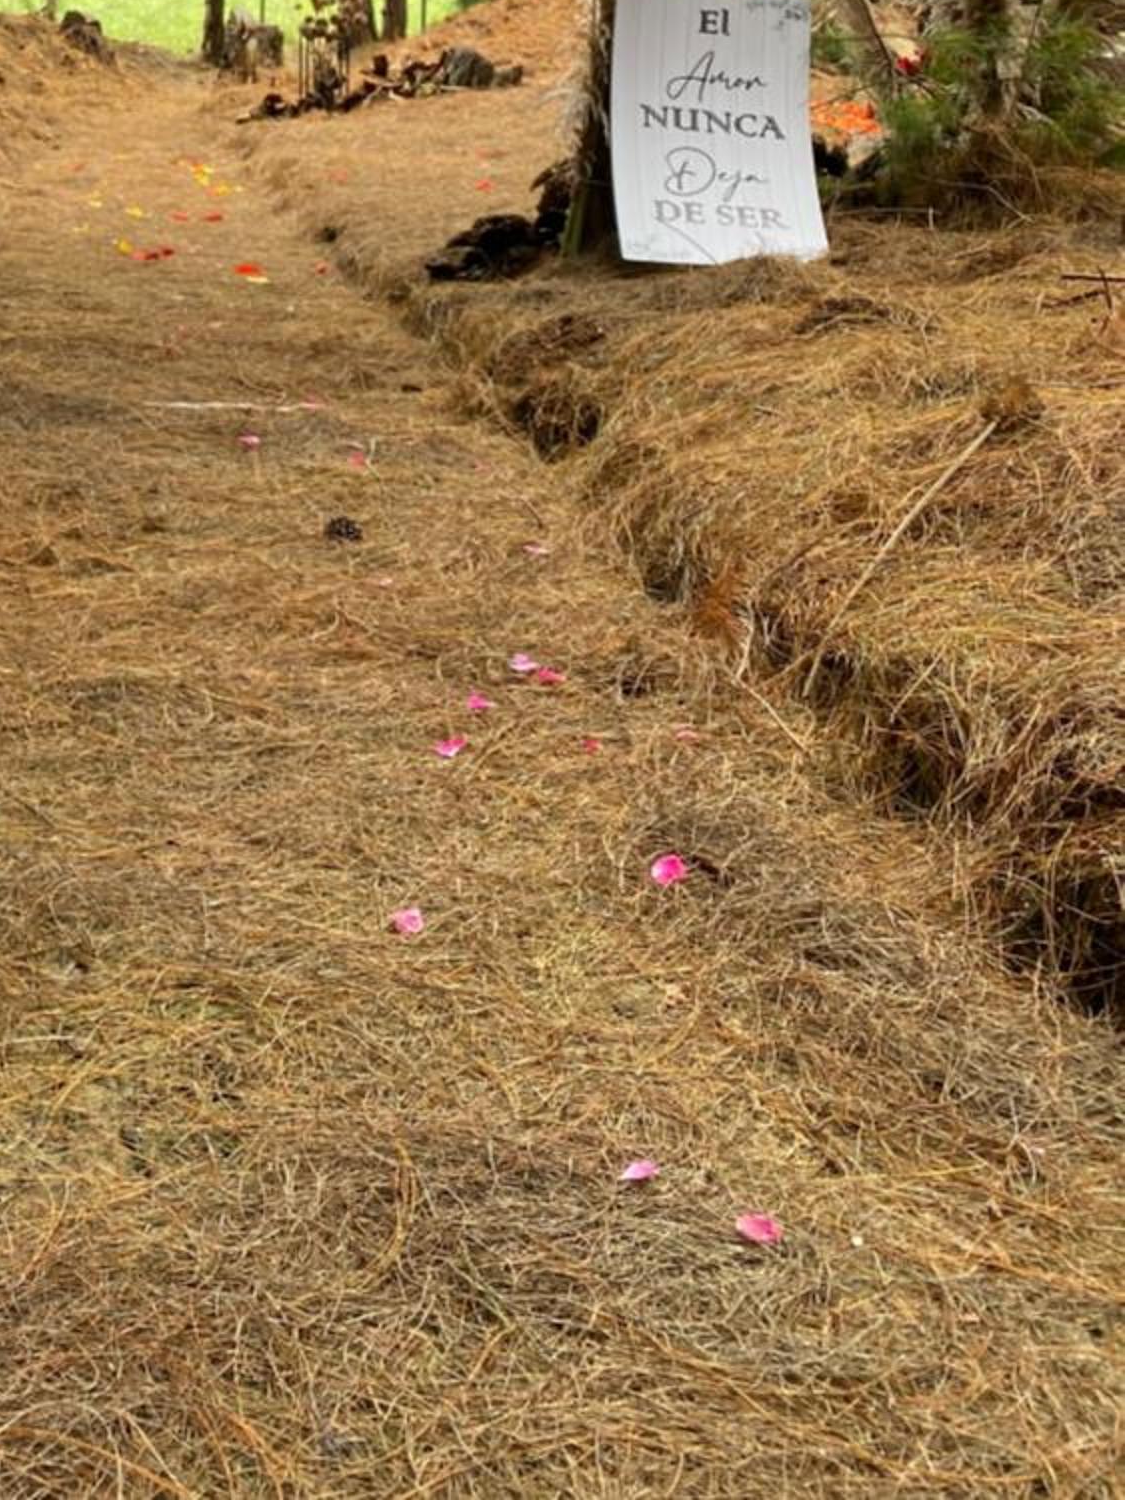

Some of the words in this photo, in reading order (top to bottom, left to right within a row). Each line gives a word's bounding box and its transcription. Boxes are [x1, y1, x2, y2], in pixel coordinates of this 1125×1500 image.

[698, 8, 730, 36] El
[666, 51, 768, 101] Amor
[639, 103, 785, 140] NUNCA
[664, 146, 768, 203] Deja
[654, 199, 706, 225] DE
[716, 203, 792, 230] SER
